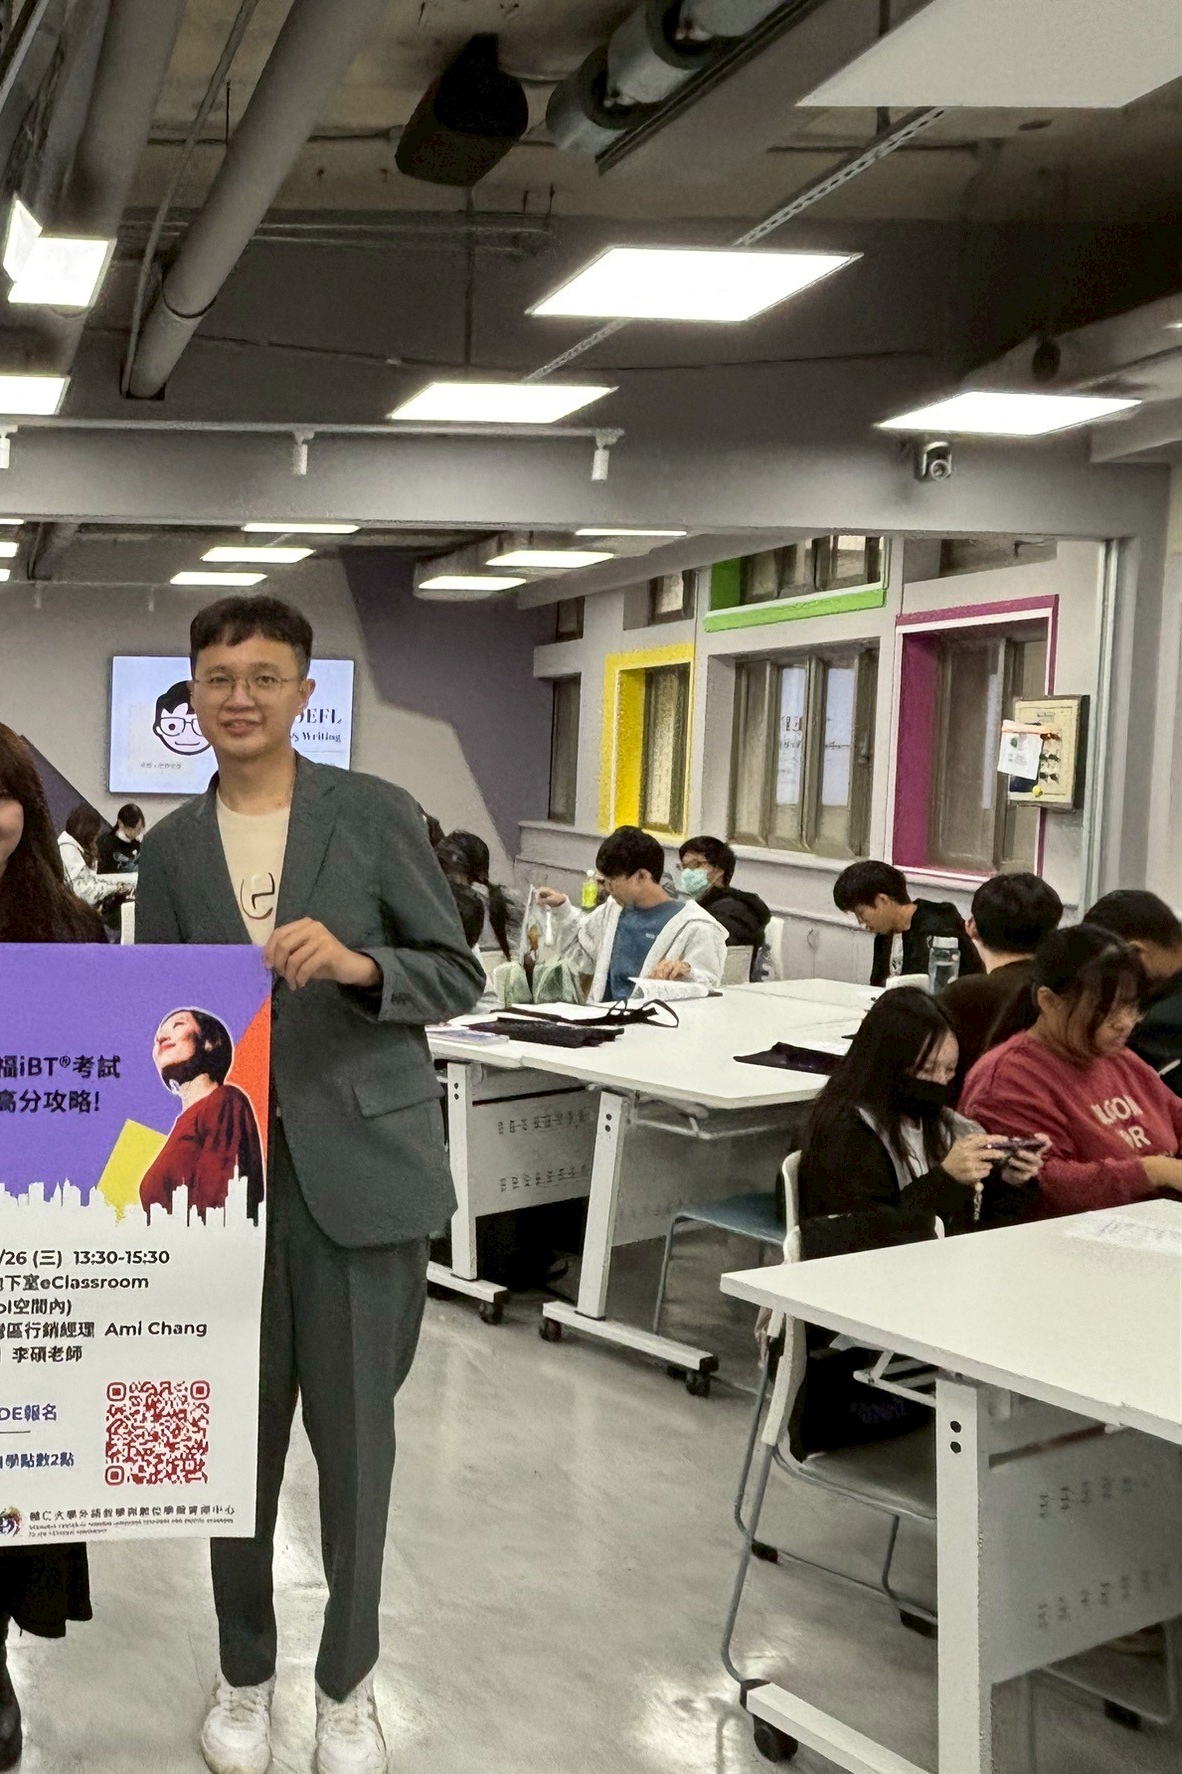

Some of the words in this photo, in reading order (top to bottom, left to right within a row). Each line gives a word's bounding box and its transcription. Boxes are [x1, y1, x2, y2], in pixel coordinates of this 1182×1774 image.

[298, 708, 342, 724] EFL
[32, 1249, 63, 1269] (三)
[73, 1250, 171, 1266] 13:30-15:30
[147, 1321, 208, 1338] Chang
